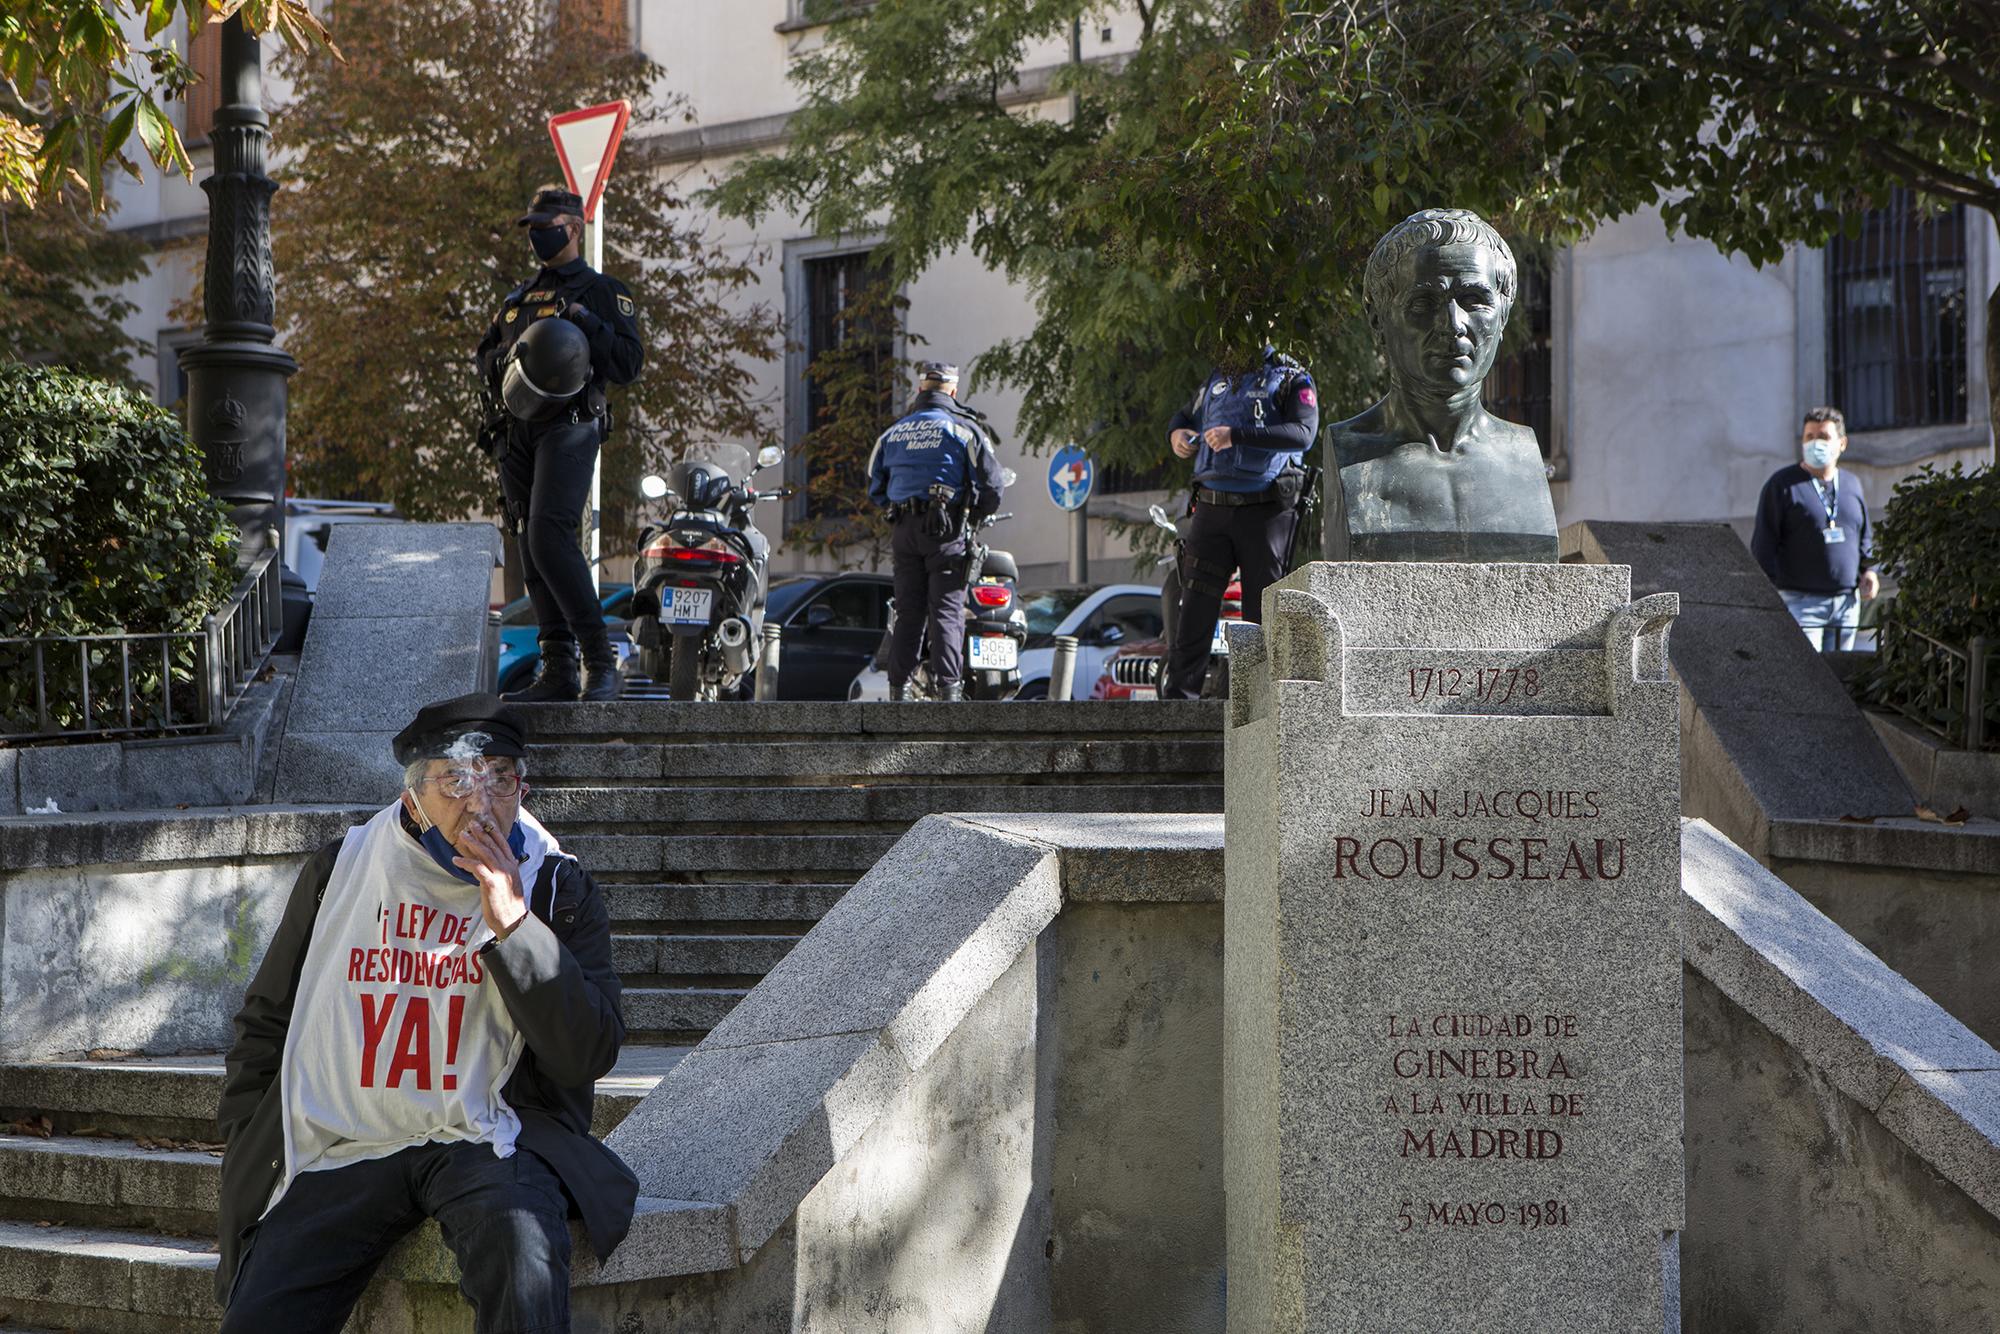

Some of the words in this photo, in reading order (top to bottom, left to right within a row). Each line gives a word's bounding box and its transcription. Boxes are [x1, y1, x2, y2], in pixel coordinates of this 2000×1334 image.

[887, 429, 943, 443] MUNICIPAL
[906, 438, 942, 450] Madrid
[675, 591, 708, 604] 9207
[673, 604, 700, 618] HMT
[981, 640, 1014, 654] 5063
[982, 655, 1007, 666] HGH
[1360, 789, 1438, 818] JEAN
[1453, 790, 1600, 823] JACQUES
[1332, 837, 1627, 881] ROUSSEAU
[438, 913, 472, 945] DE
[1389, 1015, 1421, 1037] LA
[1433, 1014, 1531, 1037] CIUDAD
[1545, 1015, 1578, 1037] DE
[360, 993, 466, 1090] YA!
[1393, 1049, 1573, 1079] GINEBRA
[1384, 1096, 1400, 1113] A
[1411, 1093, 1444, 1114] LA
[1458, 1093, 1538, 1115] VILLA
[1550, 1094, 1584, 1116] DE
[1401, 1128, 1563, 1159] MADRID
[1399, 1200, 1413, 1232] 5
